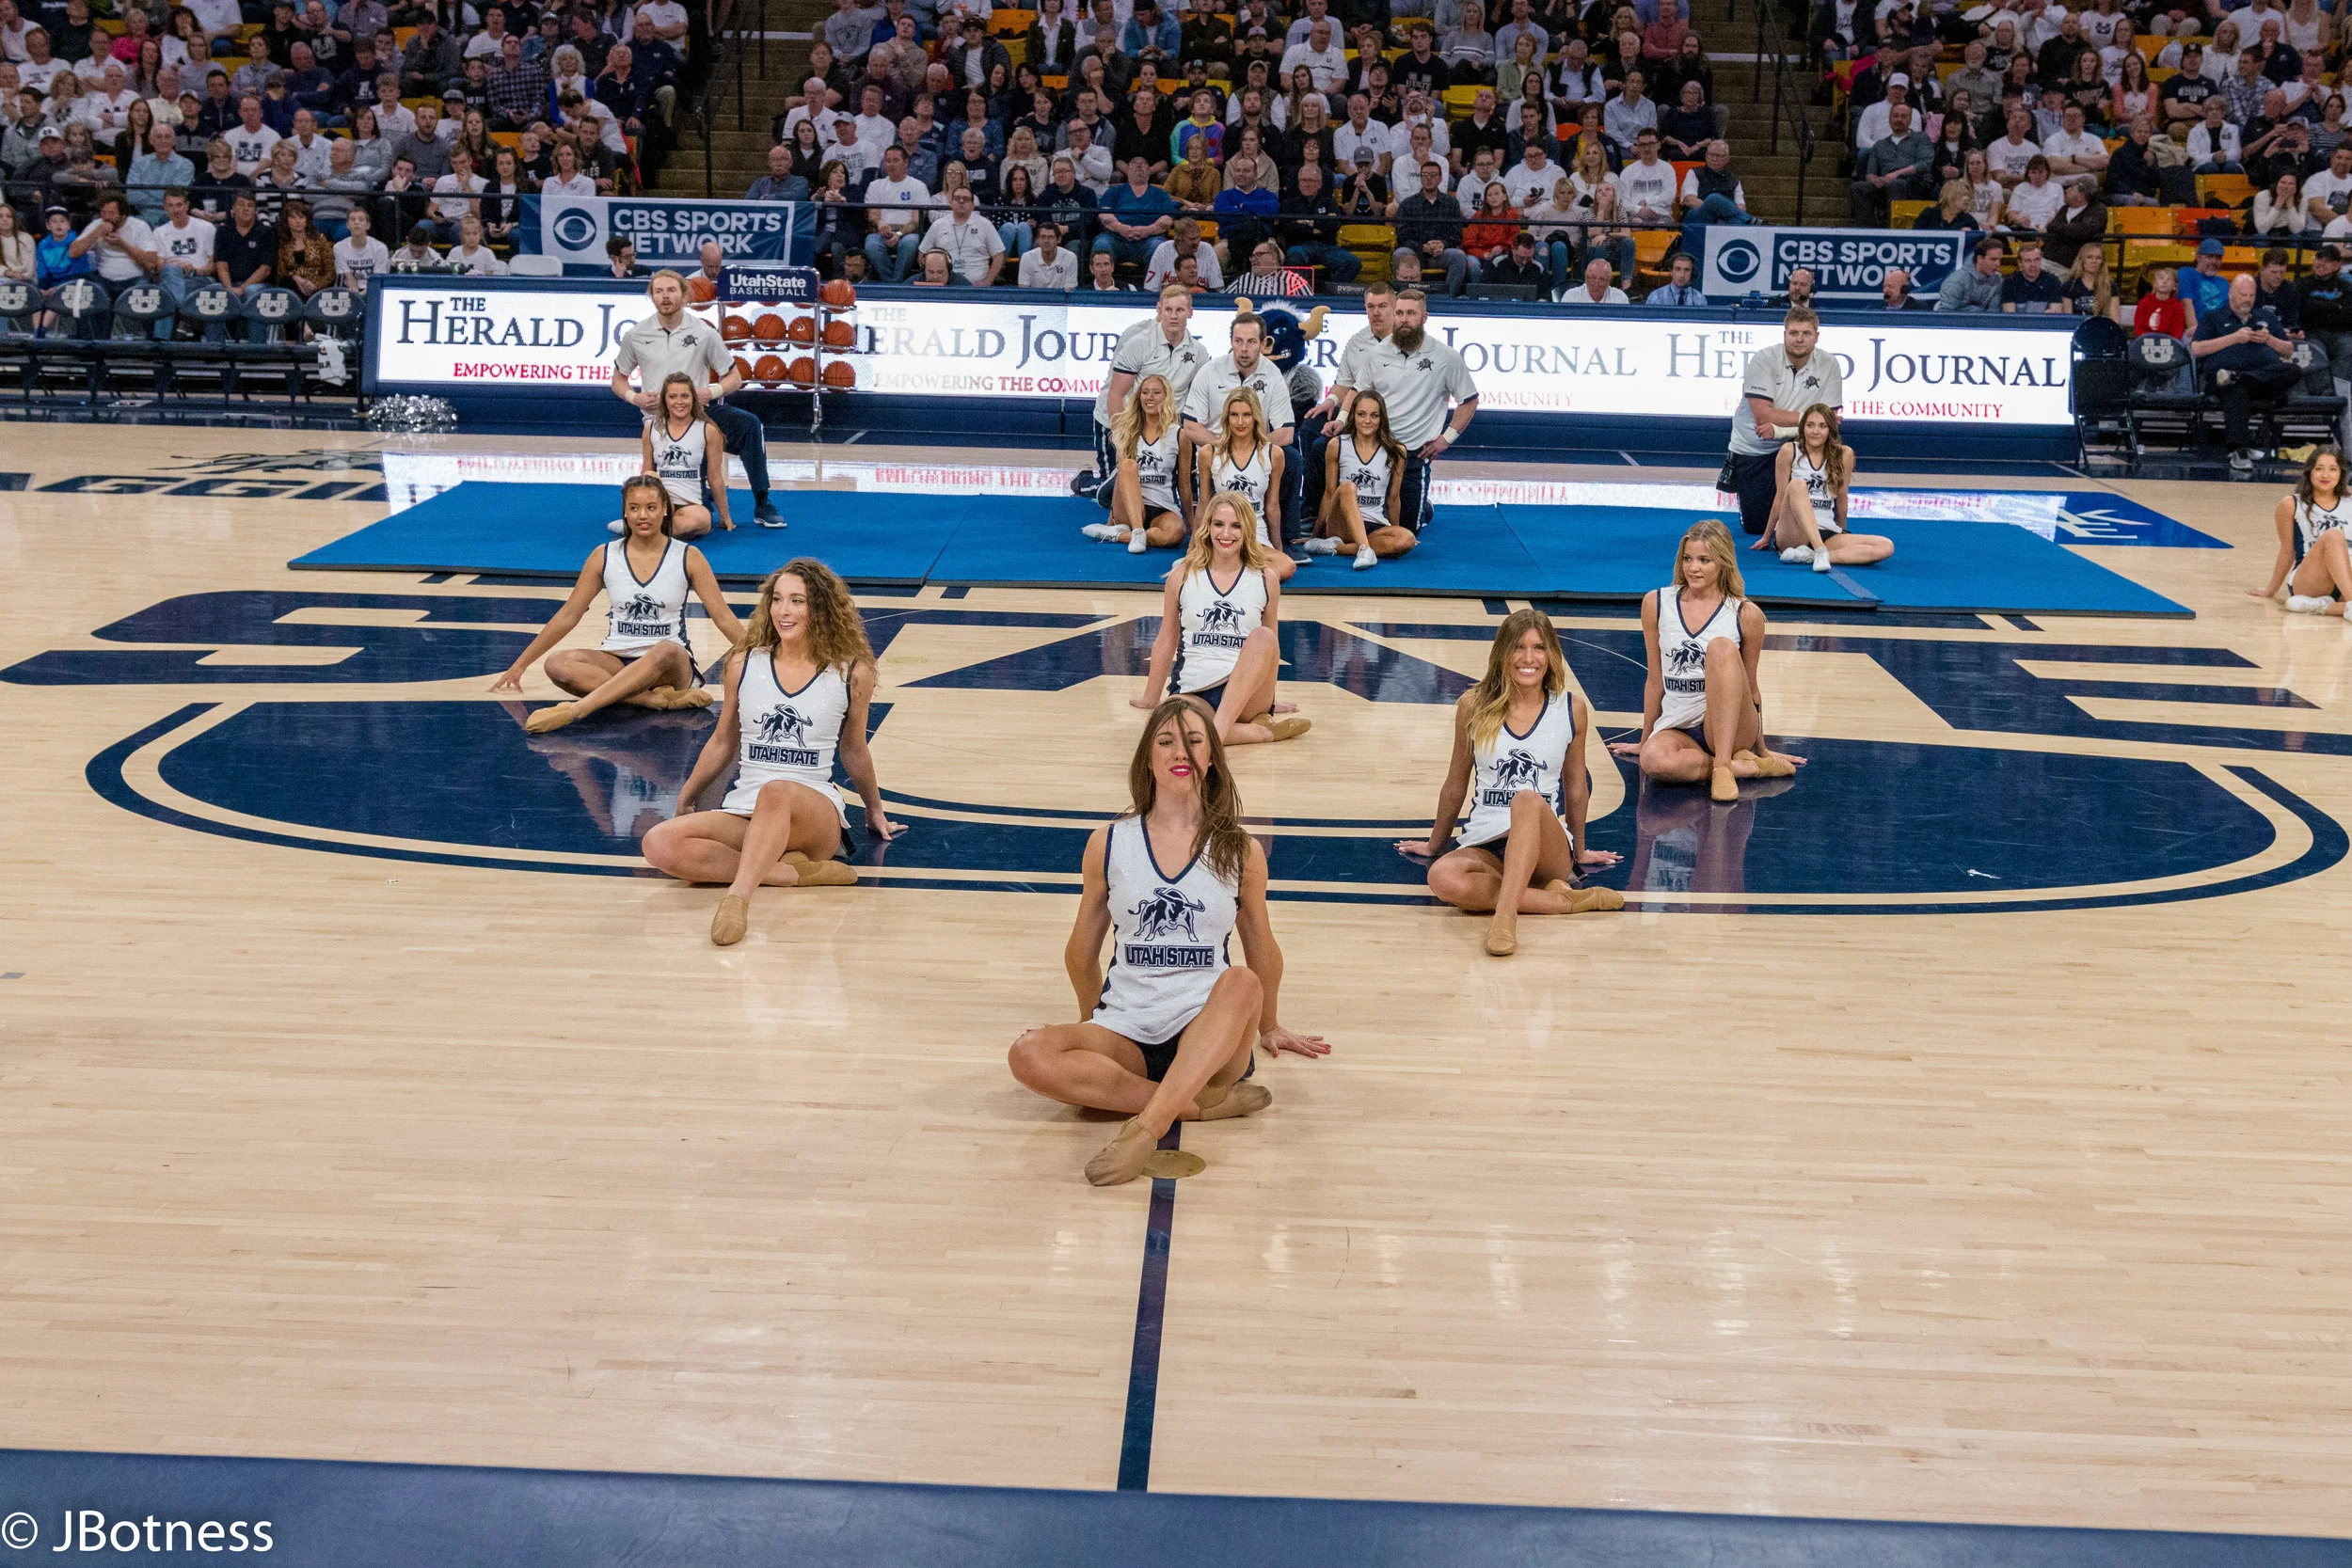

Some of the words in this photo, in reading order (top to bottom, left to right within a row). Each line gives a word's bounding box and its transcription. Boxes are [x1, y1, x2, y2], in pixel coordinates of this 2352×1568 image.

[613, 209, 667, 230] CBS
[674, 210, 781, 231] SPORTS
[1778, 240, 1834, 262] CBS
[1839, 242, 1951, 265] SPORTS
[729, 274, 806, 288] UtahState
[1778, 262, 1923, 288] NTWOK
[729, 287, 807, 296] BASKETBALL
[450, 297, 486, 311] THE
[396, 299, 584, 347] HERALD
[871, 307, 907, 322] THE
[1016, 314, 1121, 370] JOUR
[1719, 331, 1754, 344] THE
[453, 362, 572, 380] EMPOWERING
[577, 366, 612, 380] THE
[1867, 339, 2066, 392] JOURNAL
[875, 373, 993, 391] EMPOWERING
[999, 376, 1034, 392] THE
[1478, 390, 1574, 407] OMMUNITY
[1851, 401, 1884, 416] THE
[1890, 402, 2003, 419] COMMUNITY
[618, 621, 641, 636] UTAH
[642, 624, 672, 637] STATE
[1192, 633, 1220, 647] UTAH
[1220, 634, 1248, 649] STAT
[1664, 676, 1688, 692] UTAH
[749, 743, 779, 763] UTAH
[779, 747, 819, 767] STATE
[1125, 944, 1166, 967] UTAH
[1166, 945, 1215, 967] STATE
